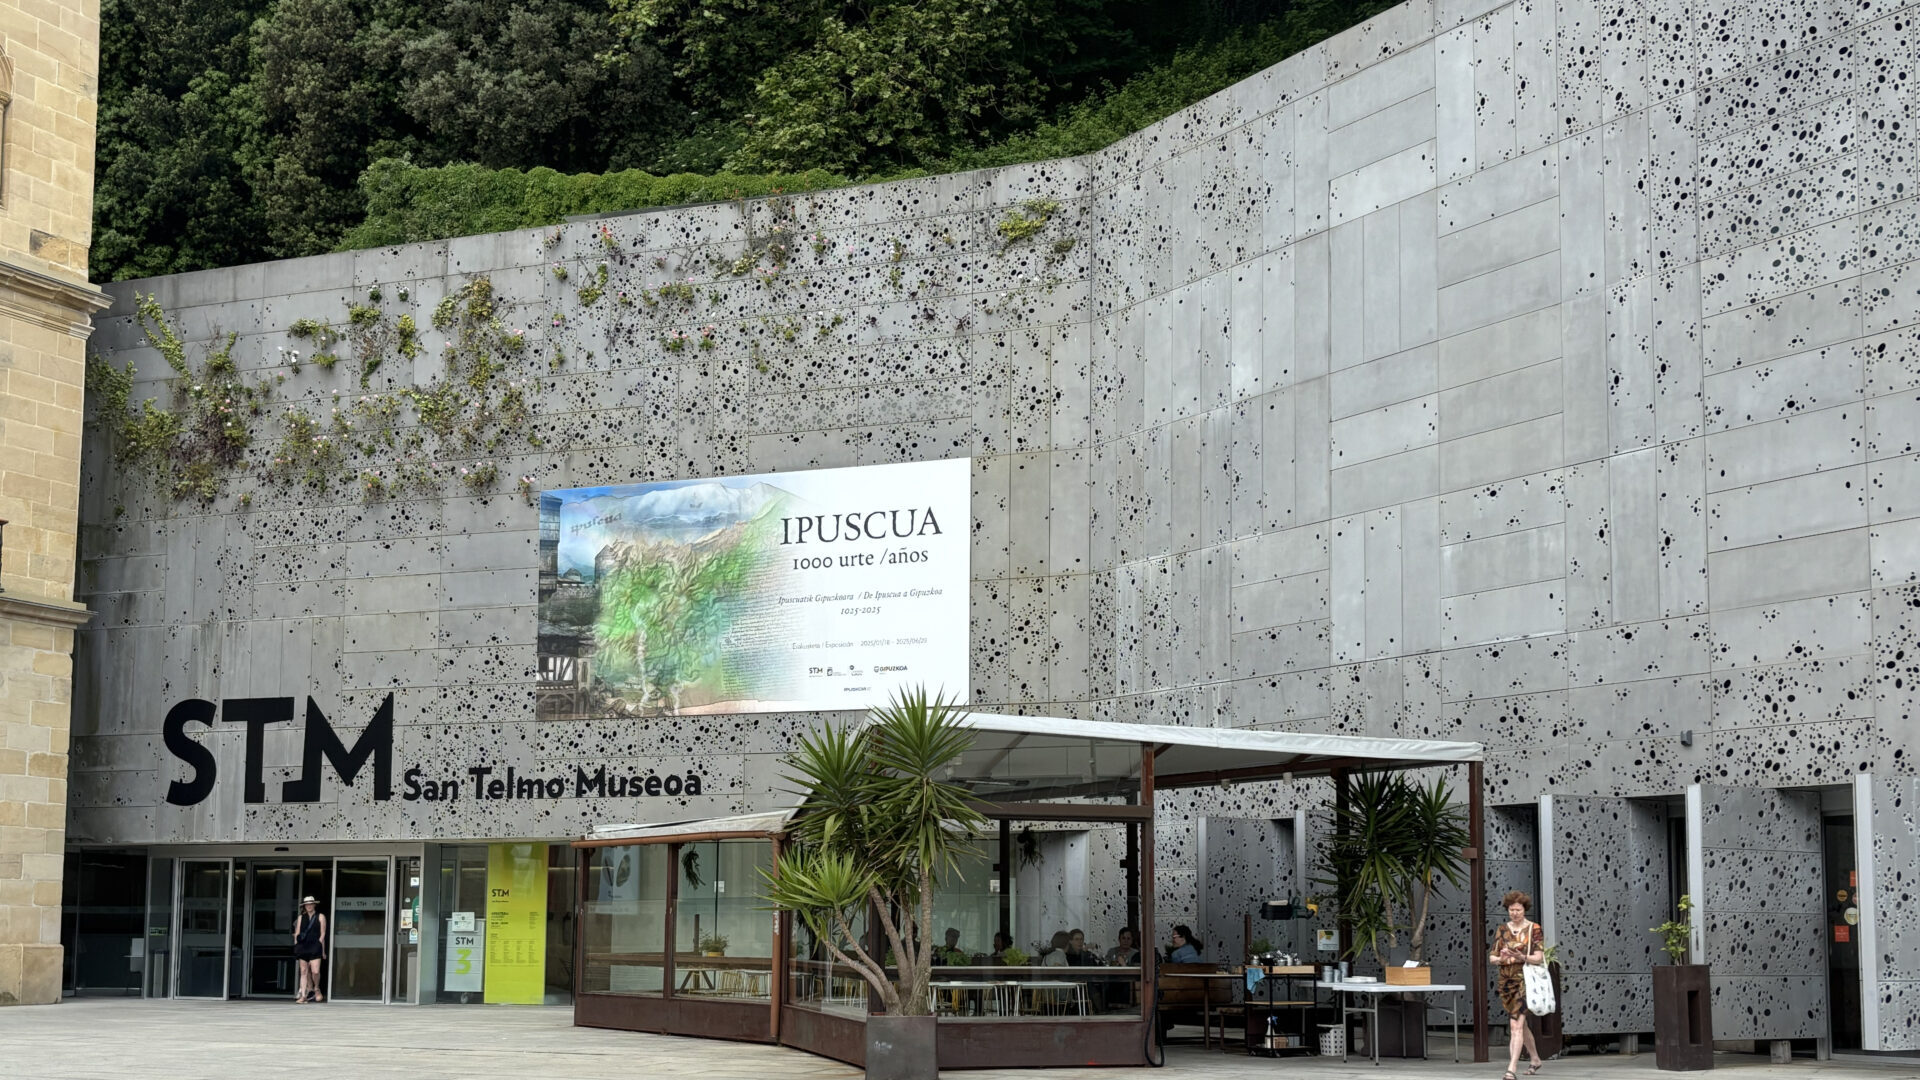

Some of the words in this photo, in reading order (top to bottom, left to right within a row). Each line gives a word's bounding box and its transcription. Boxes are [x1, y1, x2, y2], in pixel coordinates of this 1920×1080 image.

[780, 506, 943, 545] IPUSCUA
[793, 557, 833, 570] 1000
[839, 552, 875, 567] urte
[864, 590, 875, 600] De
[875, 589, 901, 600] Ipuscua
[909, 587, 943, 598] Gipuzkoa
[840, 606, 882, 615] 1025-2025
[163, 691, 394, 806] STM
[403, 768, 459, 801] San
[469, 766, 564, 800] Telmo
[576, 764, 702, 797] Museoa
[491, 888, 510, 897] STM
[455, 936, 474, 946] STM
[455, 947, 473, 975] 3
